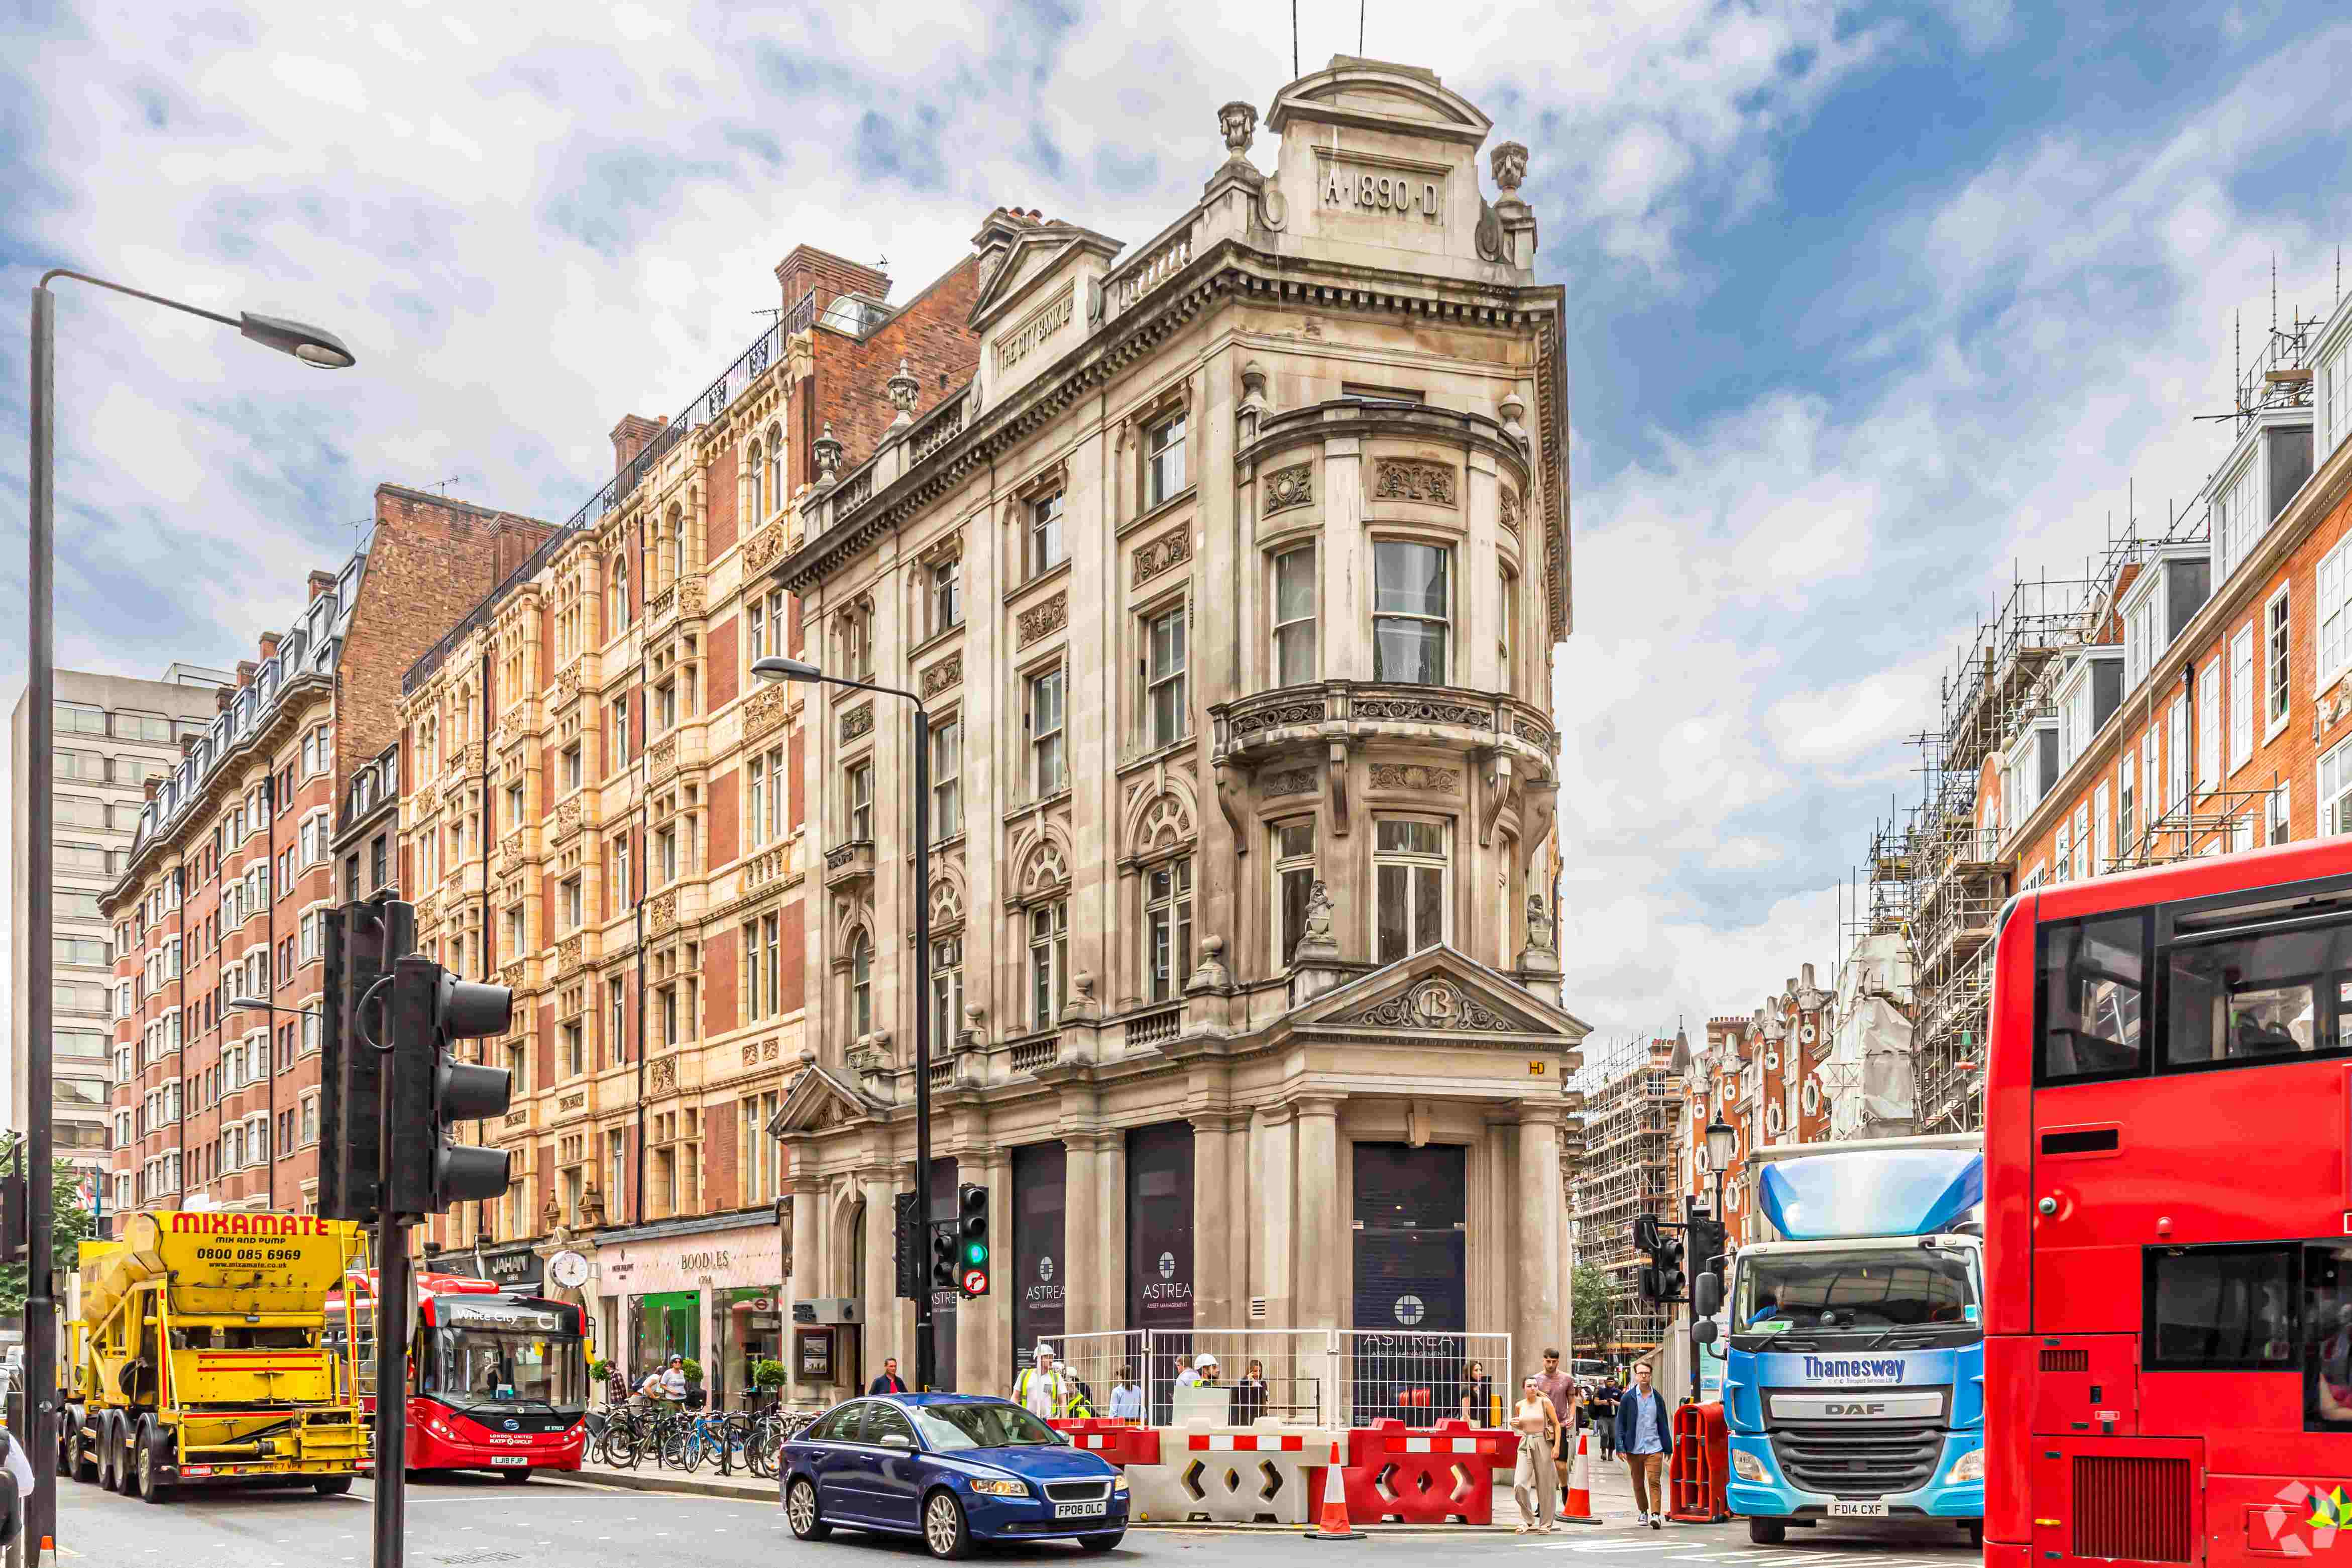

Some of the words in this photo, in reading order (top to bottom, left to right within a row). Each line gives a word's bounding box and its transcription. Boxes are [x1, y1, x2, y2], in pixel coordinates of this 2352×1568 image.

[999, 339, 1017, 372] THE
[1019, 323, 1037, 359] CITY
[1038, 304, 1061, 342] BANK
[172, 1212, 329, 1236] MIXAMATE
[196, 1248, 232, 1260] 0800
[237, 1249, 262, 1260] 085
[267, 1249, 301, 1261] 6969
[681, 1250, 729, 1270] BOODLES
[1142, 1282, 1192, 1299] ASTREA
[457, 1309, 491, 1321] White
[494, 1311, 518, 1325] City
[537, 1312, 559, 1330] C1
[1803, 1356, 1906, 1383] Thamesway
[1825, 1403, 1885, 1415] DAF
[1058, 1504, 1083, 1516] FP08
[1085, 1503, 1102, 1514] OLC
[1834, 1504, 1858, 1514] FD14
[1861, 1504, 1882, 1514] CXF
